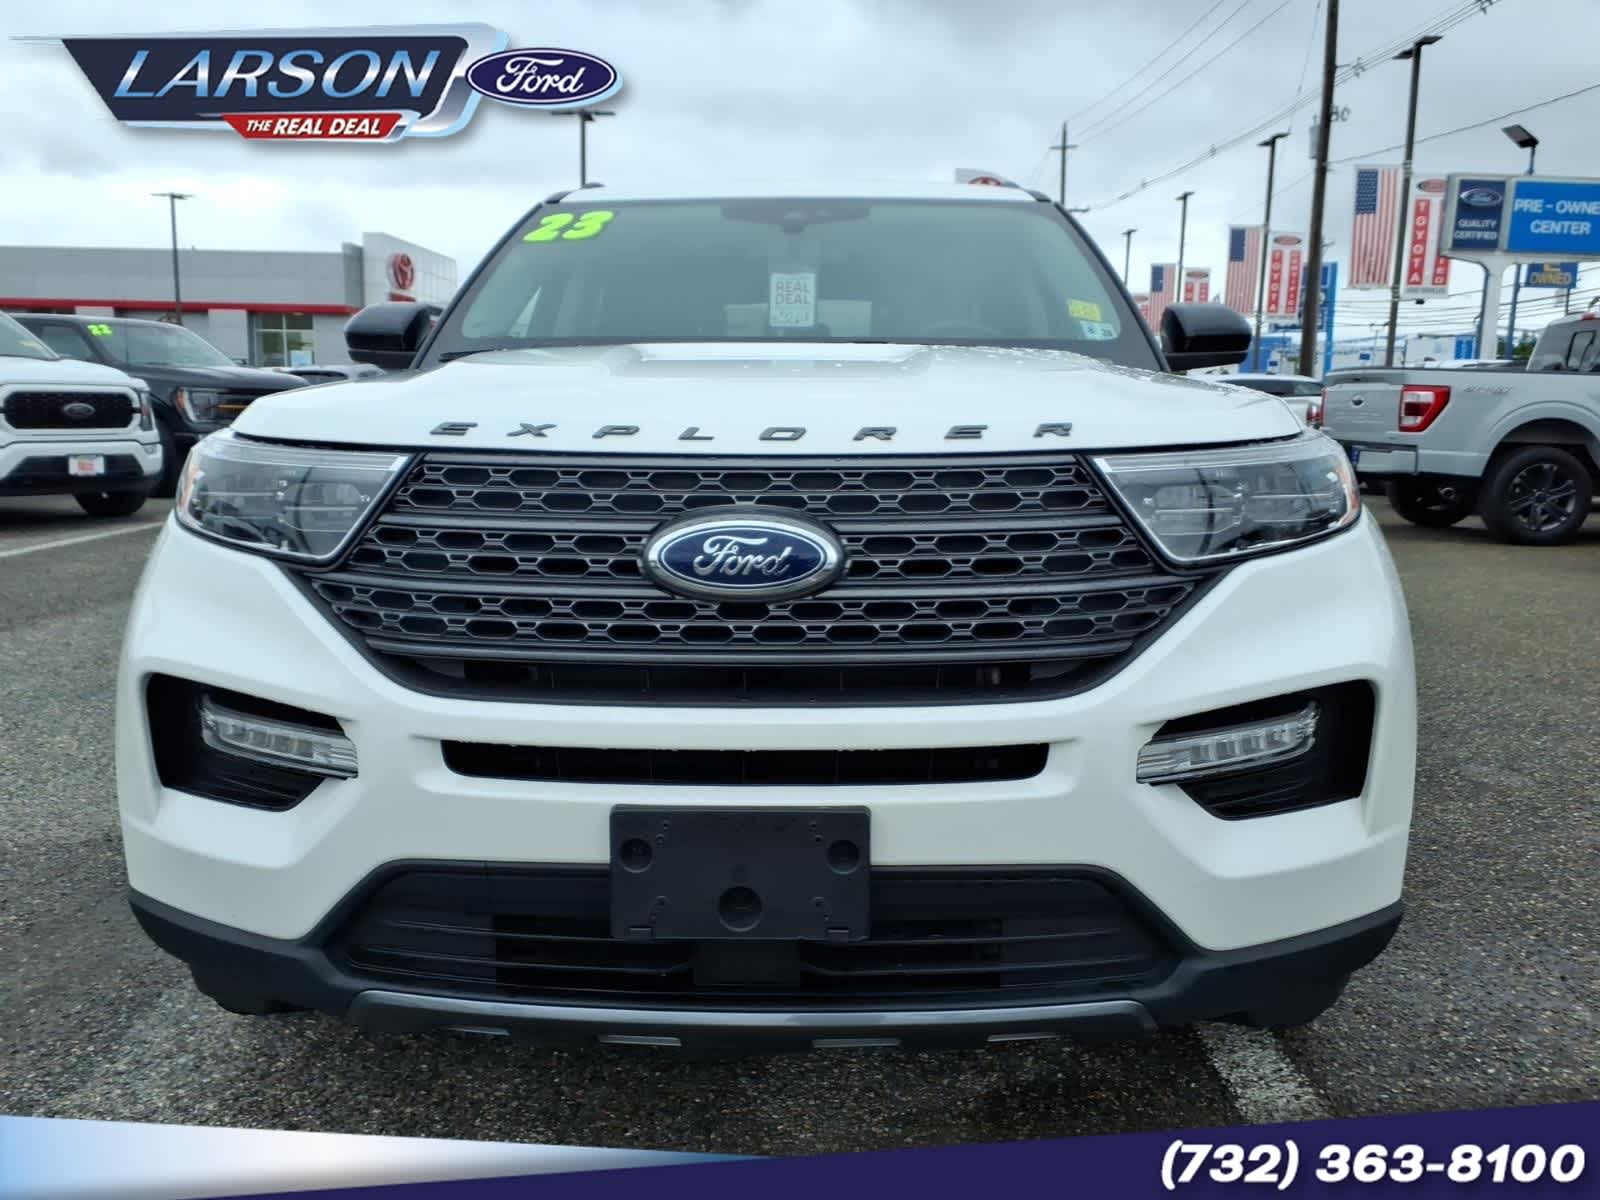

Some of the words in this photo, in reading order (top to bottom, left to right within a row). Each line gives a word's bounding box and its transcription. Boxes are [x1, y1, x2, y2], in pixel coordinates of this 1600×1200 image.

[1513, 198, 1544, 213] PRE
[522, 209, 615, 242] 23
[1458, 218, 1497, 229] QUALITY
[1530, 219, 1592, 236] CENTER
[1409, 201, 1427, 284] TOYOTA
[1454, 230, 1498, 241] CERTIFIED
[1529, 271, 1572, 286] OWNED
[775, 292, 811, 305] DEAL
[87, 324, 113, 337] 22
[429, 421, 1075, 442] EXPLORER
[692, 535, 793, 576] Ford
